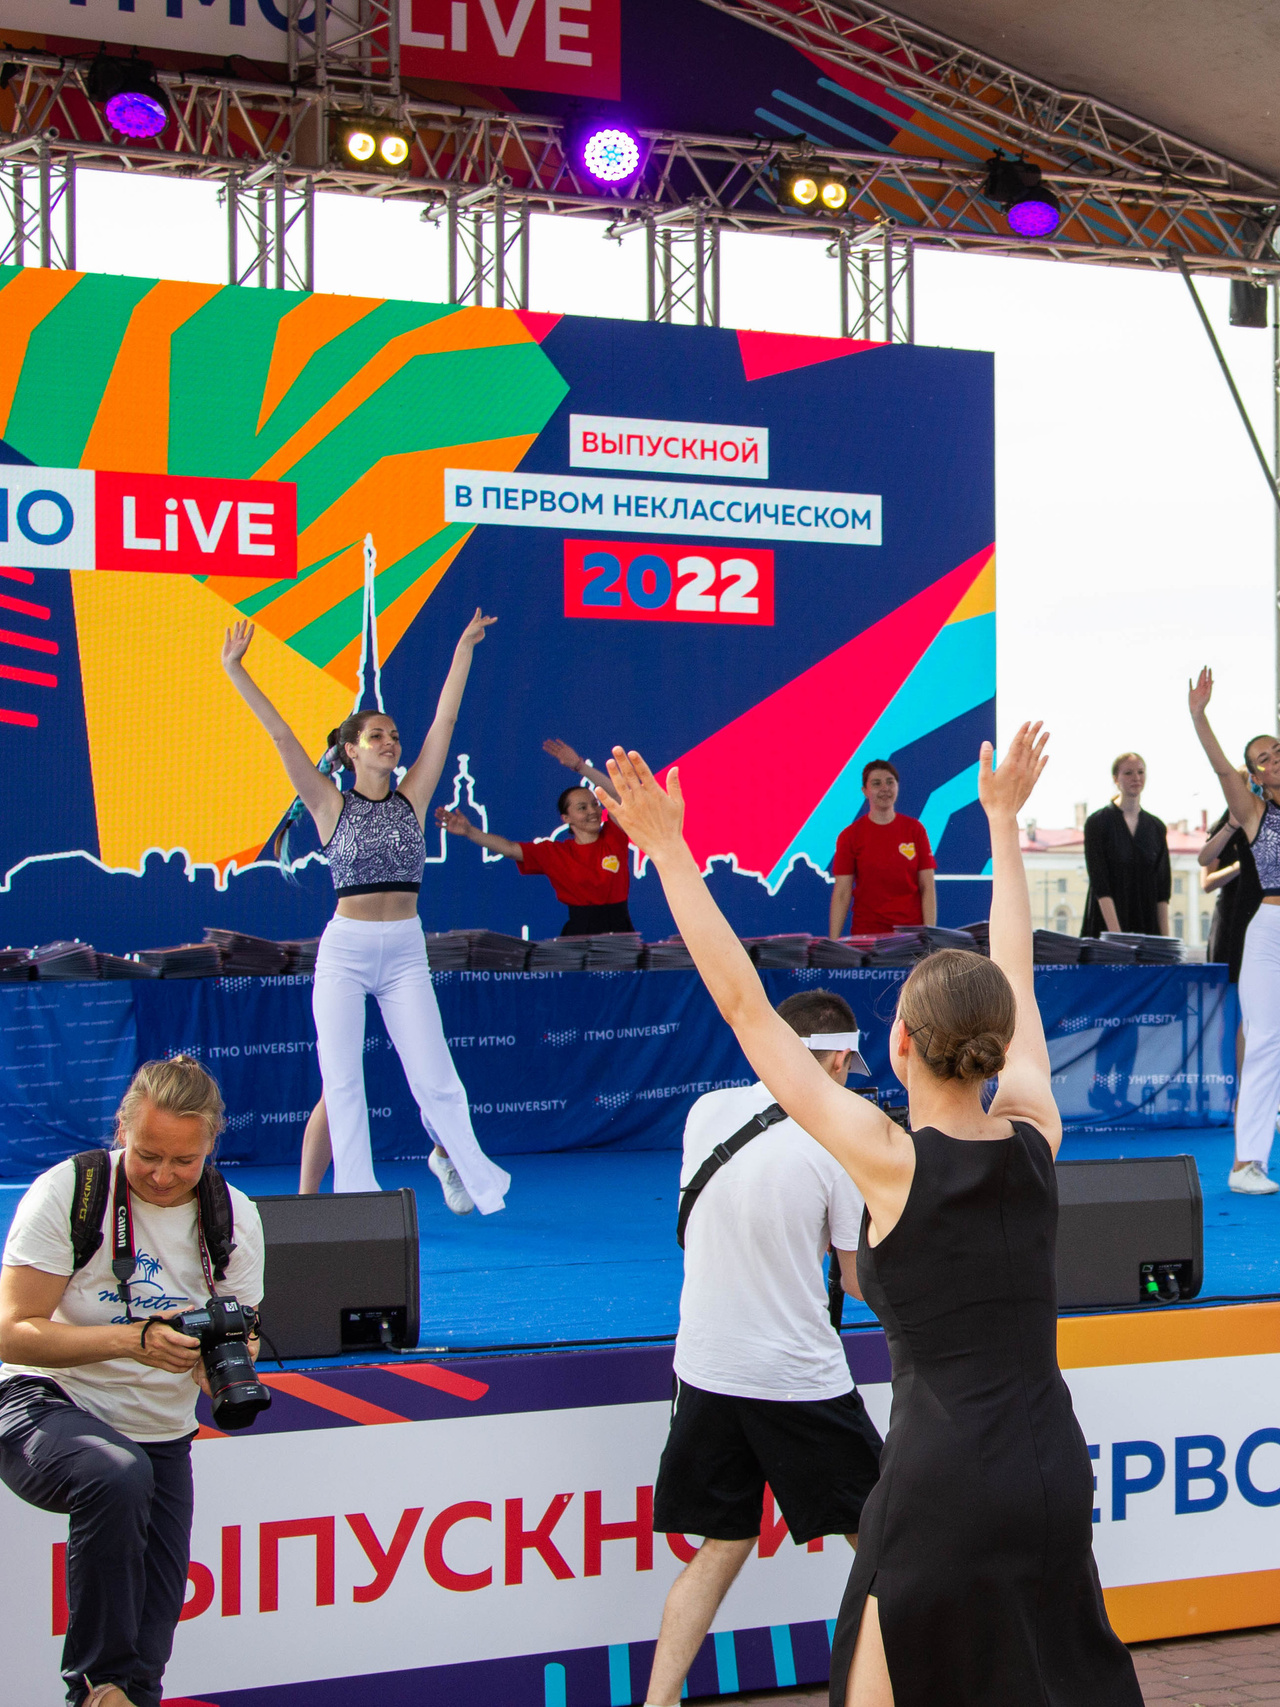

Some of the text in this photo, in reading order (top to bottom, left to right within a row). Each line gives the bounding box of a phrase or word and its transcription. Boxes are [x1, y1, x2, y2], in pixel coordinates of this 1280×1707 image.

[581, 430, 760, 464] ВЫПУСКНОЙ
[455, 484, 872, 530] В ПЕРВОМ НЕКЛАССИЧЕСКОМ
[581, 552, 760, 614] 2022
[478, 1035, 516, 1047] ИТМО
[584, 1030, 615, 1042] ITMO
[208, 1041, 315, 1059] ITMO UNIVERSITY
[495, 1099, 567, 1113] UNIVERSITY
[118, 1205, 127, 1248] Canon
